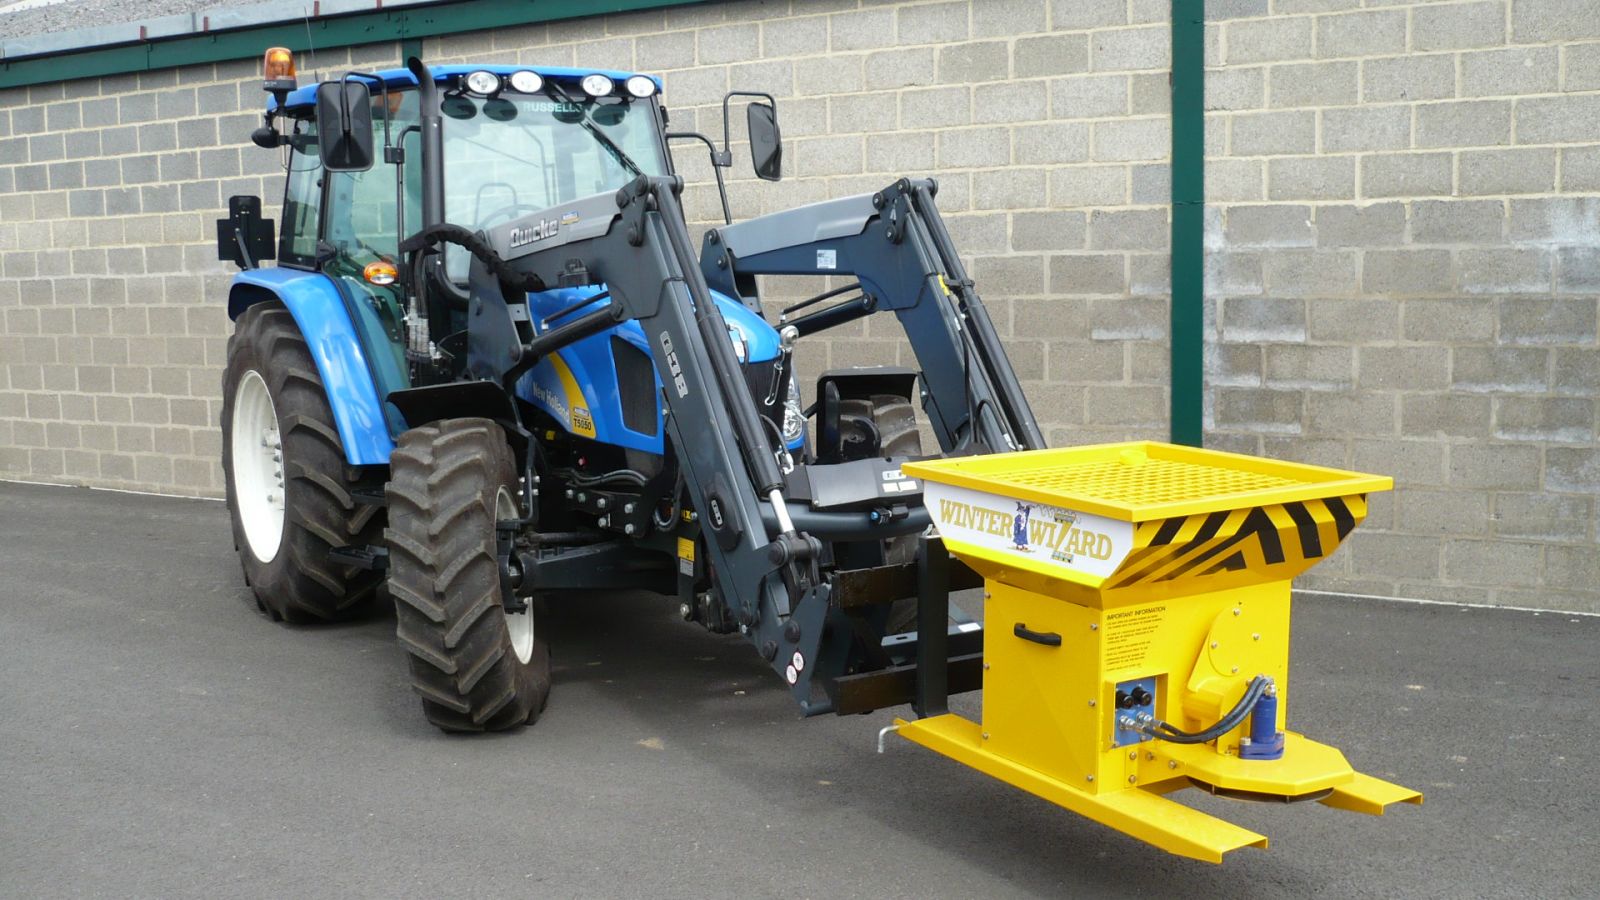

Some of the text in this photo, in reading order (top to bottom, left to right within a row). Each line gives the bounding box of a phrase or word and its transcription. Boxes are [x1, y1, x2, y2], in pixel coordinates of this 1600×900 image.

[510, 218, 560, 248] Quicke
[533, 381, 570, 425] New Holland
[939, 499, 1113, 561] WINTER WIZARD
[1106, 606, 1167, 620] IMPORTANT INFORMATION
